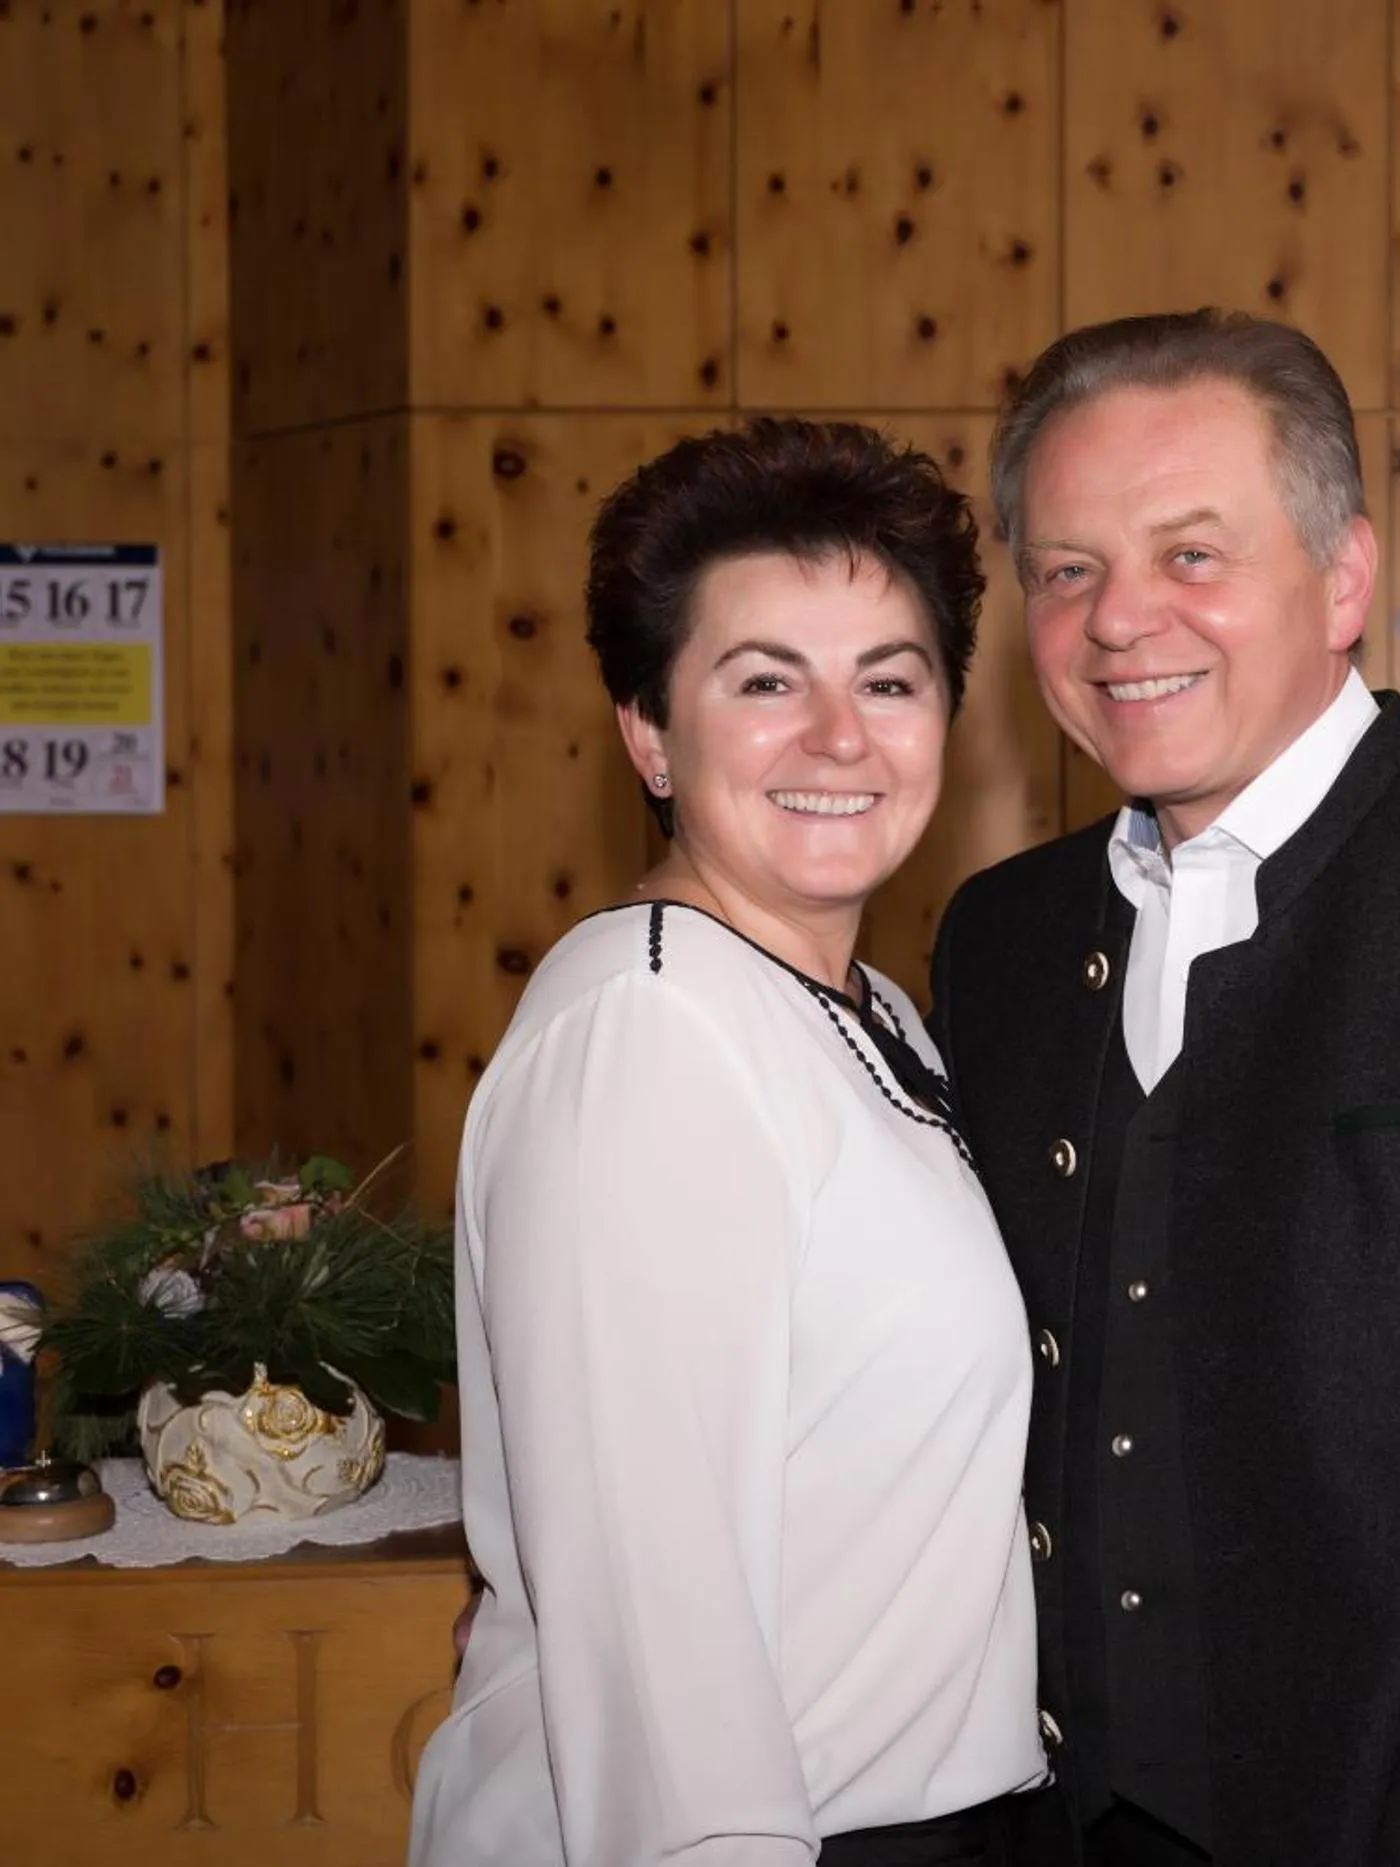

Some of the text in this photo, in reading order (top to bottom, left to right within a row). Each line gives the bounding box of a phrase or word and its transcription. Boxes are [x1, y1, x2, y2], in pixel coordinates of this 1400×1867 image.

[0, 579, 149, 623] 5 16 17
[0, 738, 29, 780] 8
[43, 738, 90, 780] 19
